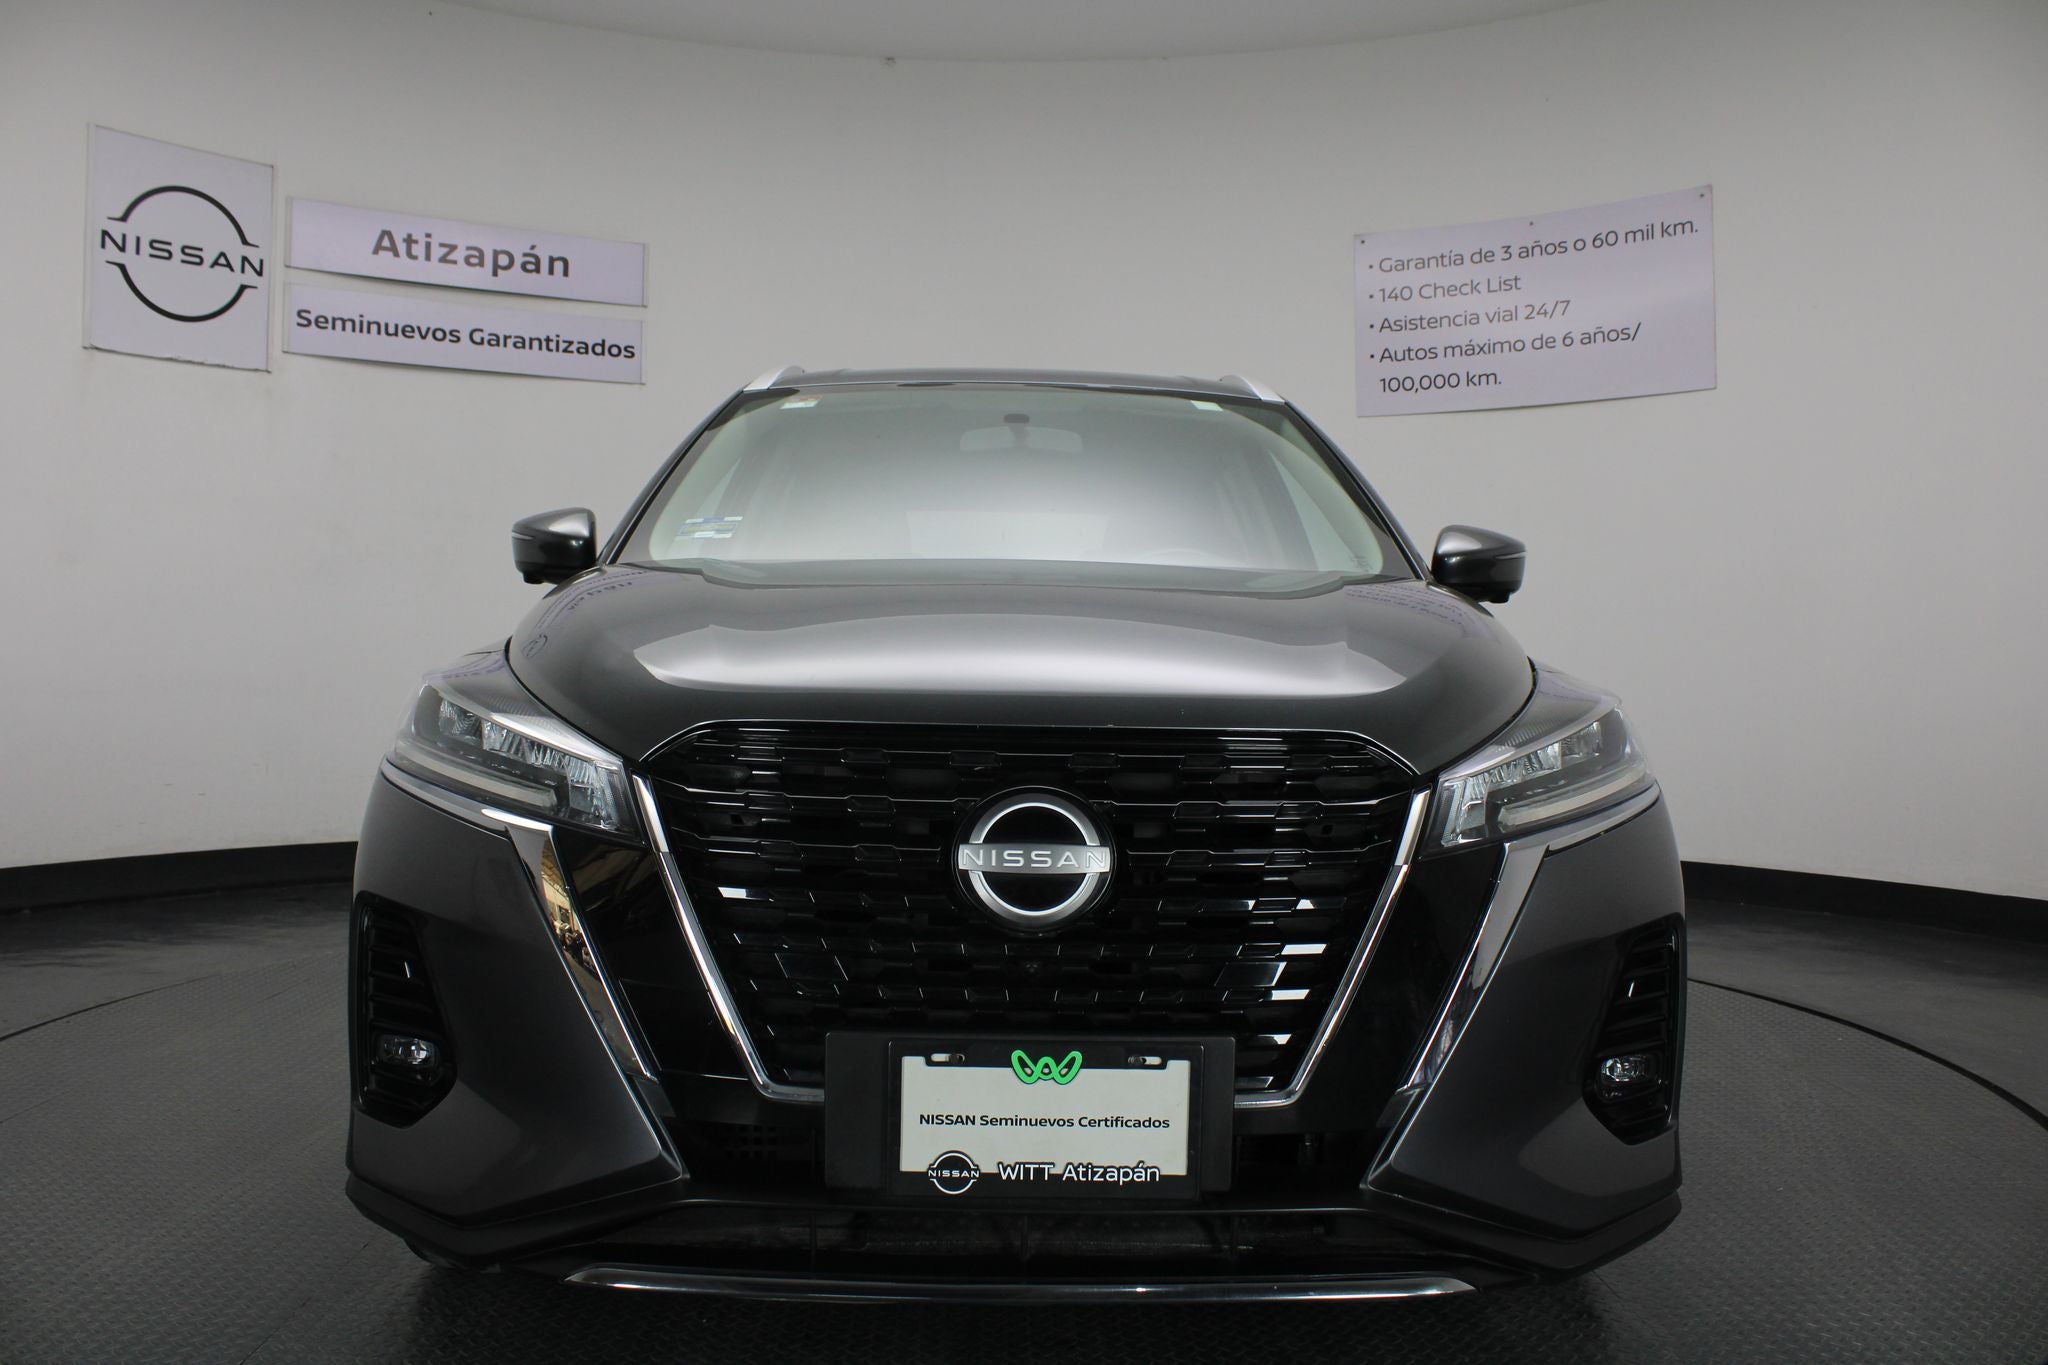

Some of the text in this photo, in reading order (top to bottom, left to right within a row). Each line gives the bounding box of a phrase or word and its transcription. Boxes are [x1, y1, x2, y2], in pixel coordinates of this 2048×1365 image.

[100, 229, 264, 277] NISSAN
[371, 229, 571, 278] Atizapán
[1379, 218, 1699, 273] Garantía de 3 años o 60 mil km.
[1379, 274, 1522, 303] 140 Check List
[1379, 300, 1571, 333] Asistencia vial 24/7
[295, 308, 636, 359] Seminuevos Garantizados
[1379, 322, 1642, 364] Autos máximo de 6 años/
[1379, 369, 1503, 395] 100,000 km.
[963, 849, 1107, 868] NISSAN
[919, 1114, 1170, 1129] NISSAN Seminuevos Certificados
[928, 1168, 980, 1179] NISSAN
[998, 1162, 1160, 1186] WITT Atizapán
